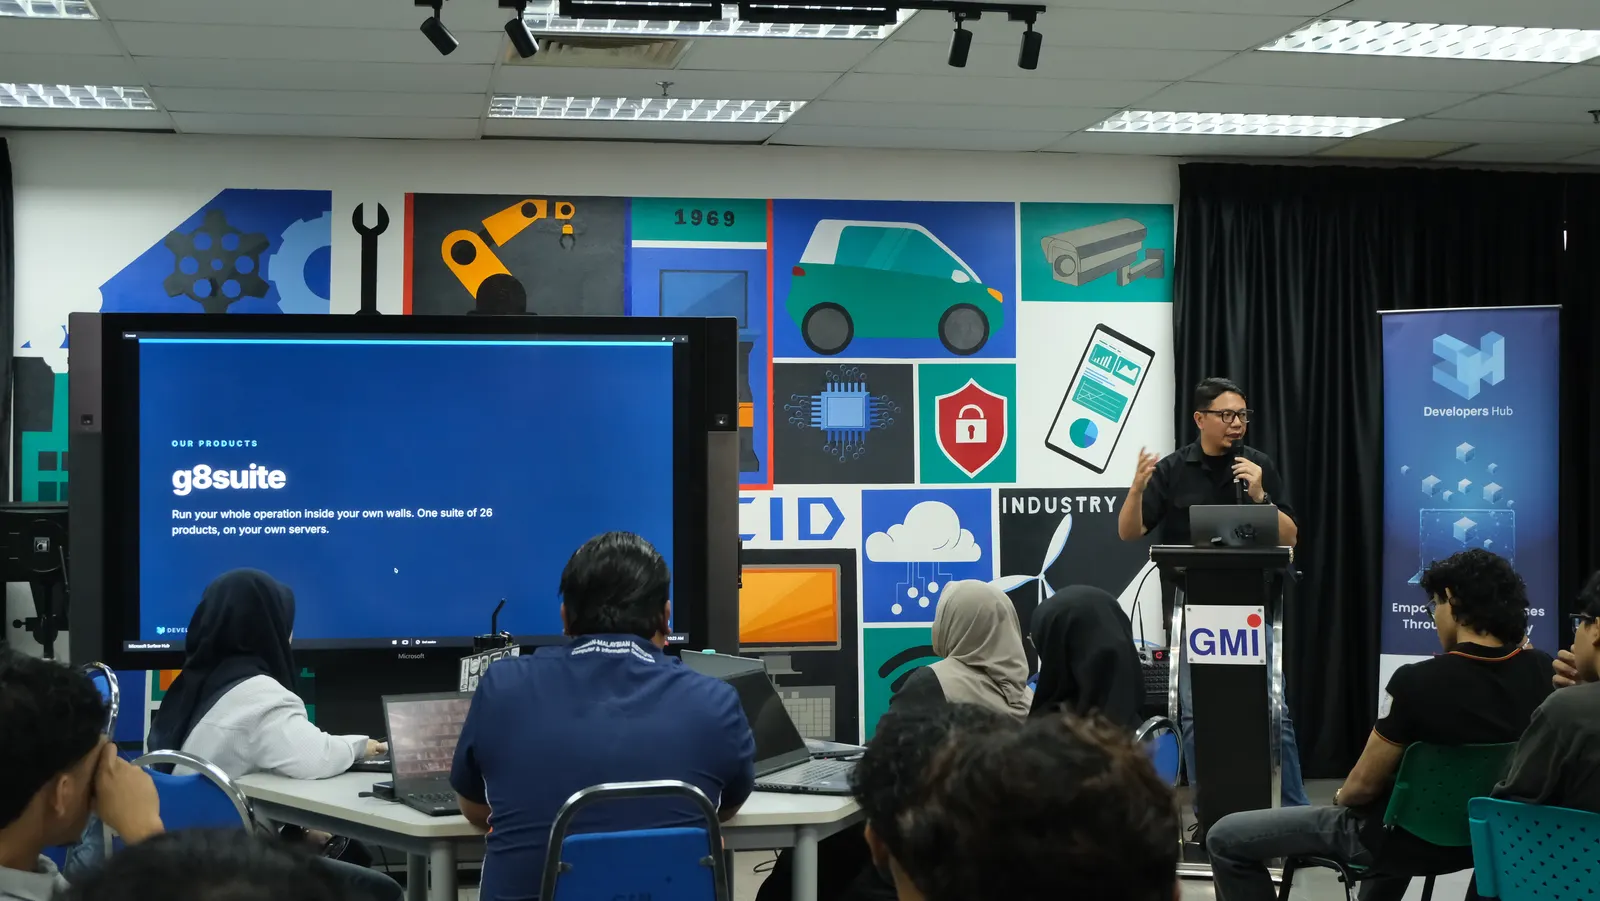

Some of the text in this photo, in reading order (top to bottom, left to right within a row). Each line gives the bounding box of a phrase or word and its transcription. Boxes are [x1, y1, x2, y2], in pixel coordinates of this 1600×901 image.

[674, 208, 735, 227] 1969
[1423, 406, 1513, 419] Developers Hub
[172, 463, 287, 496] g8suite
[1002, 496, 1117, 514] INDUSTRY
[171, 508, 493, 521] Run your whole operation inside your own walls. One suite of 26
[171, 525, 330, 536] products, on your own servers.
